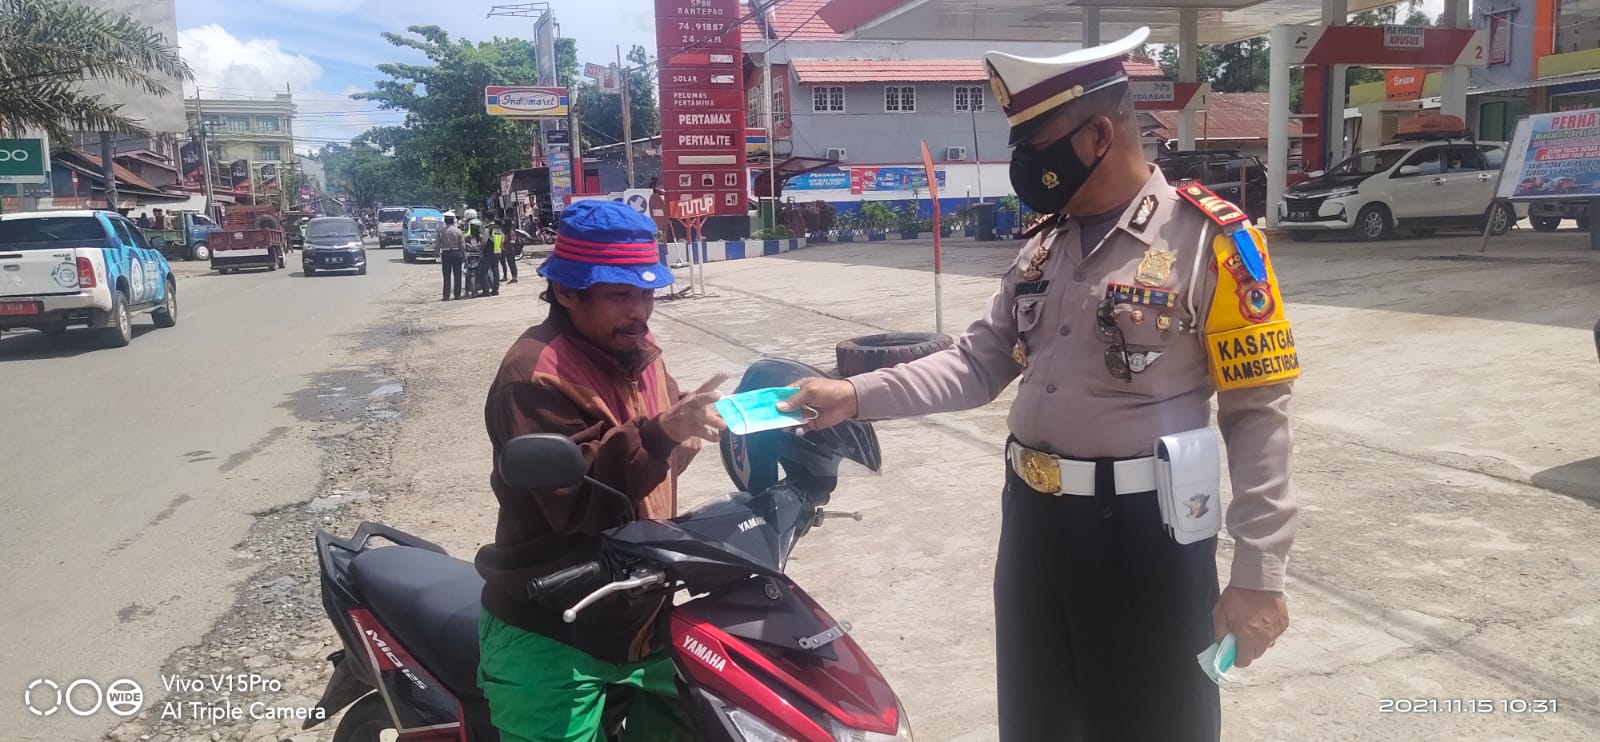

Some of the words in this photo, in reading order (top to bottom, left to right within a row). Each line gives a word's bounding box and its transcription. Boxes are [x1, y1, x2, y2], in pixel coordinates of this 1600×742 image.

[1390, 35, 1419, 46] KHUSUS
[1475, 46, 1483, 59] 2
[672, 75, 698, 83] SOLAR
[501, 94, 555, 107] Indomaret
[1202, 94, 1206, 105] 1
[678, 113, 732, 125] PERTAMAX
[1551, 111, 1600, 130] PERHA
[678, 134, 731, 146] PERTALITE
[677, 196, 714, 217] TUTUP
[682, 634, 727, 672] YAMAHA
